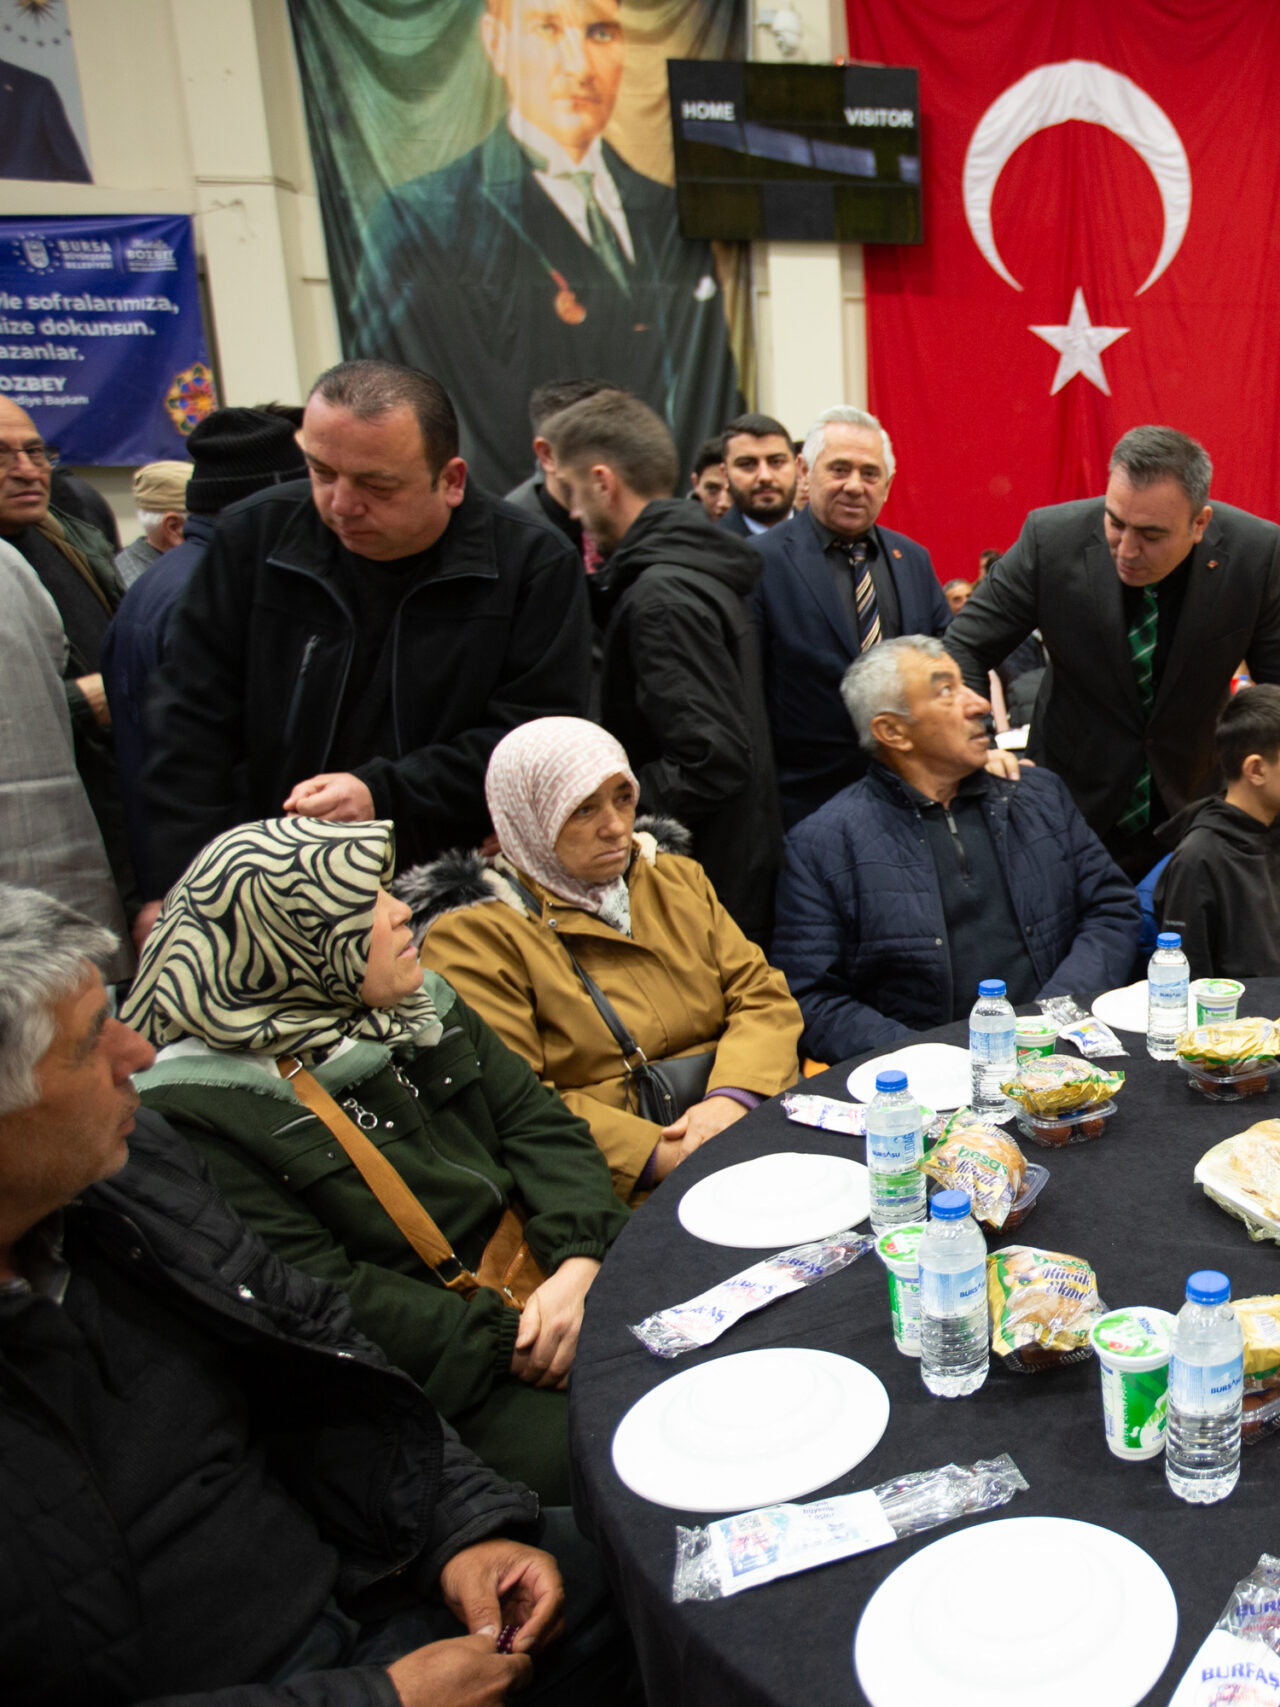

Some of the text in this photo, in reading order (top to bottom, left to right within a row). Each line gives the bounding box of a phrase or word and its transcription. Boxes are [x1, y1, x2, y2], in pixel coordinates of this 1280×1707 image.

[681, 101, 735, 121] HOME
[844, 107, 914, 128] VISITOR
[57, 239, 113, 252] BURSA
[26, 292, 180, 315] sofralarımıza,
[41, 318, 156, 337] dokunsun.
[1201, 1662, 1280, 1691] BURFAŞ
